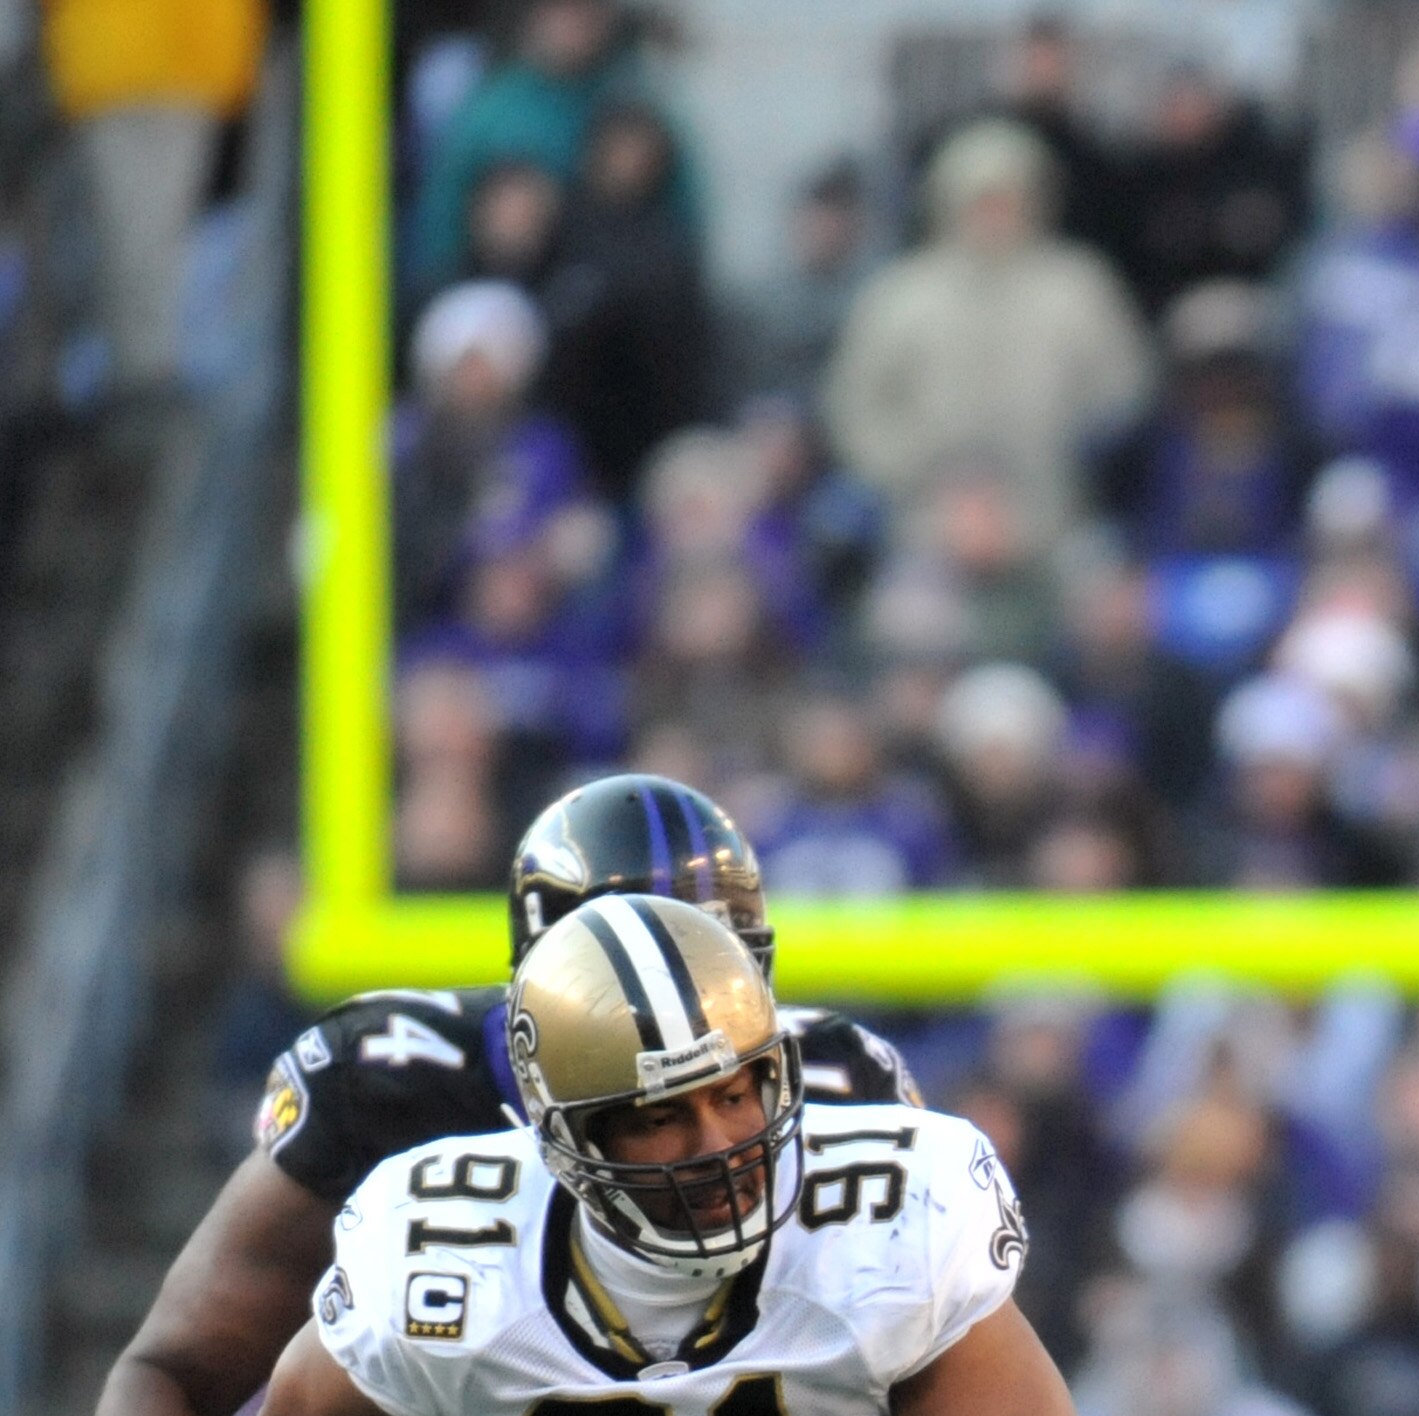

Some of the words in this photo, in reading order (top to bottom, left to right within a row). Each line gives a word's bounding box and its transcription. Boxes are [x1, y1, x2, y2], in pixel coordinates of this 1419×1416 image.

[660, 1042, 714, 1068] Riddell
[405, 1152, 522, 1257] 91
[797, 1126, 918, 1235] 91
[408, 1274, 465, 1323] C
